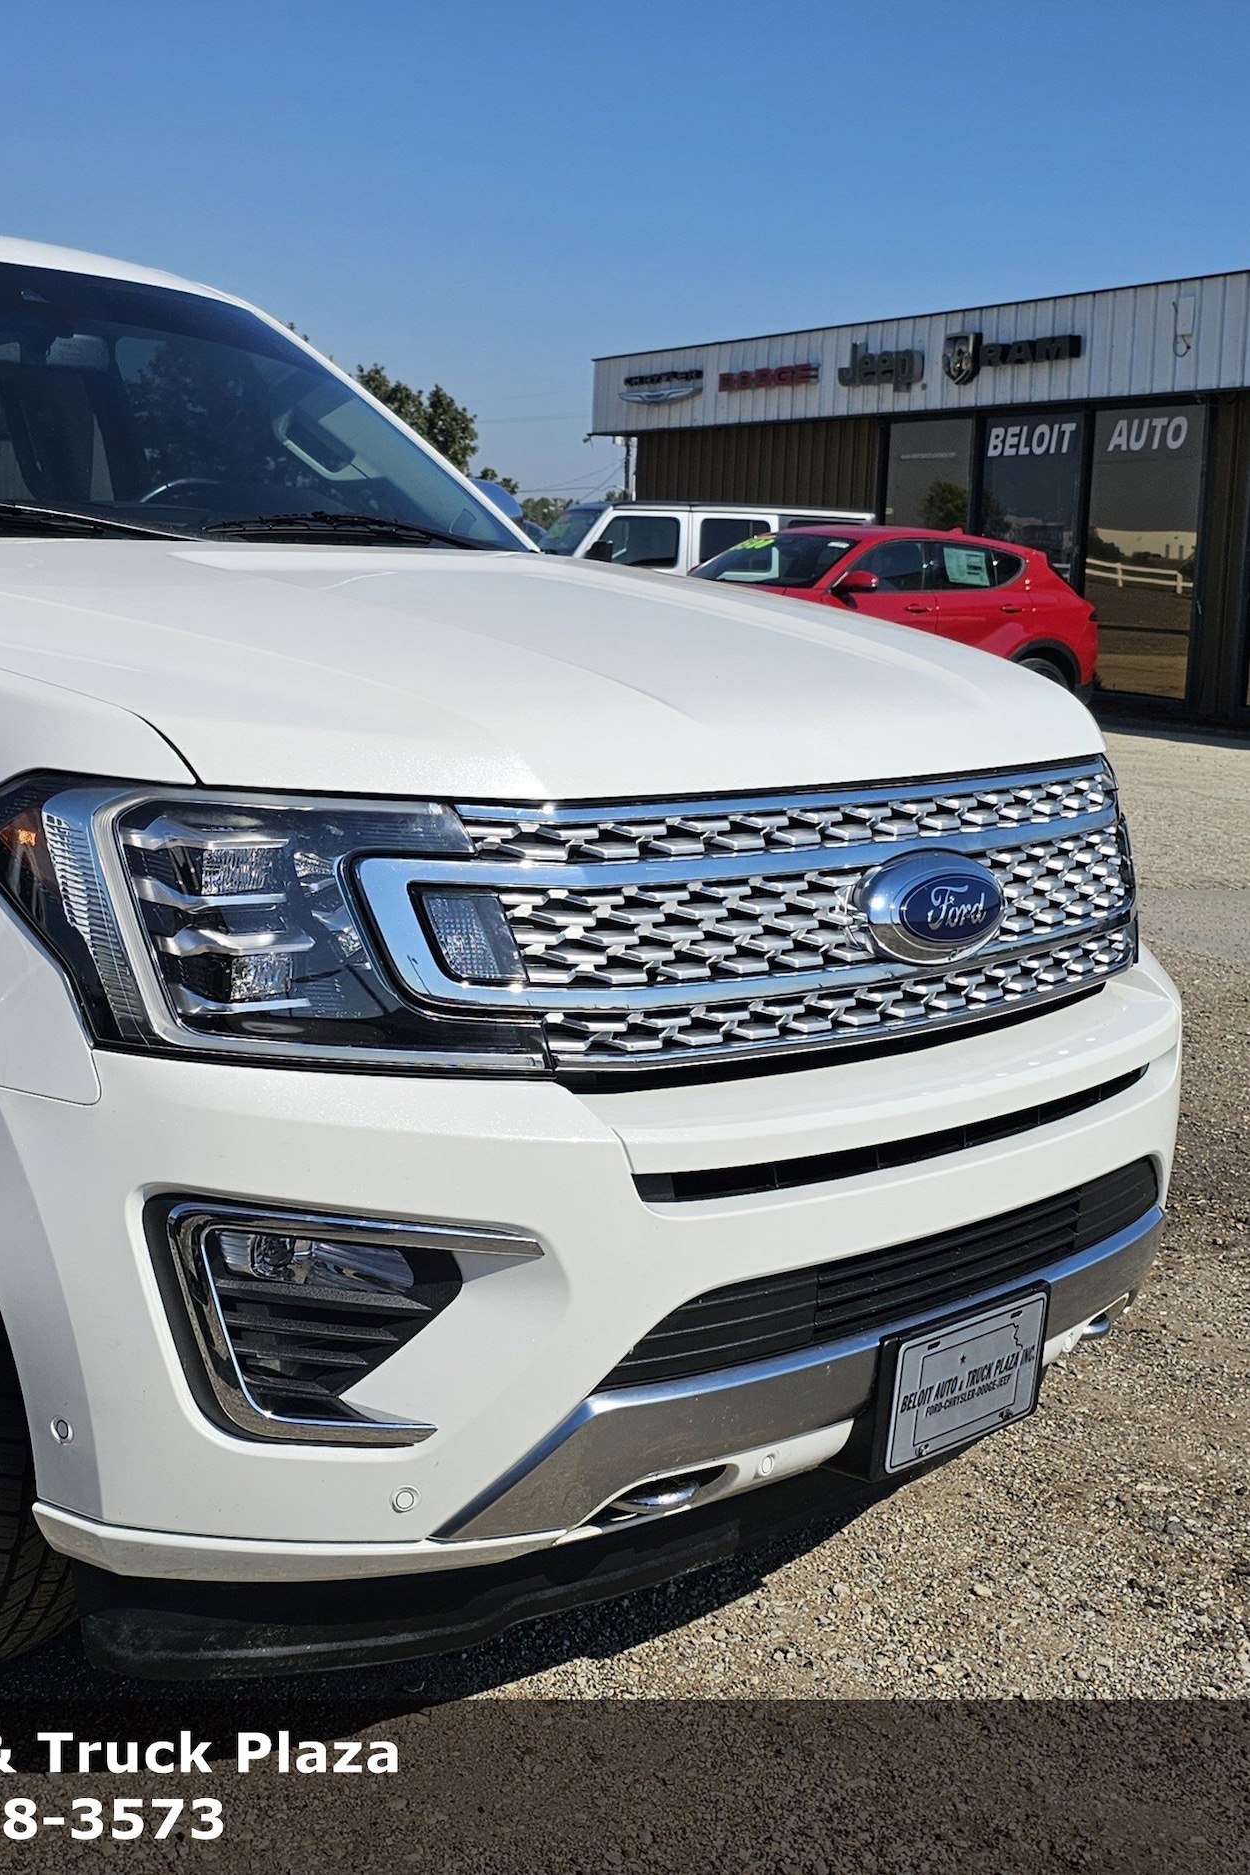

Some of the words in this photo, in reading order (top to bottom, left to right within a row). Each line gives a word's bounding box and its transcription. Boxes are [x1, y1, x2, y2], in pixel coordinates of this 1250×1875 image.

[838, 341, 924, 393] Jeep
[979, 335, 1082, 367] RAM
[718, 363, 815, 392] DODGE
[987, 423, 1077, 457] BELOIT
[1107, 416, 1188, 452] AUTO
[927, 884, 987, 931] Ford
[900, 1385, 934, 1414] BELOIT
[934, 1375, 958, 1401] AUTO
[965, 1361, 994, 1389] TRUCK
[994, 1351, 1020, 1378] PLAZA
